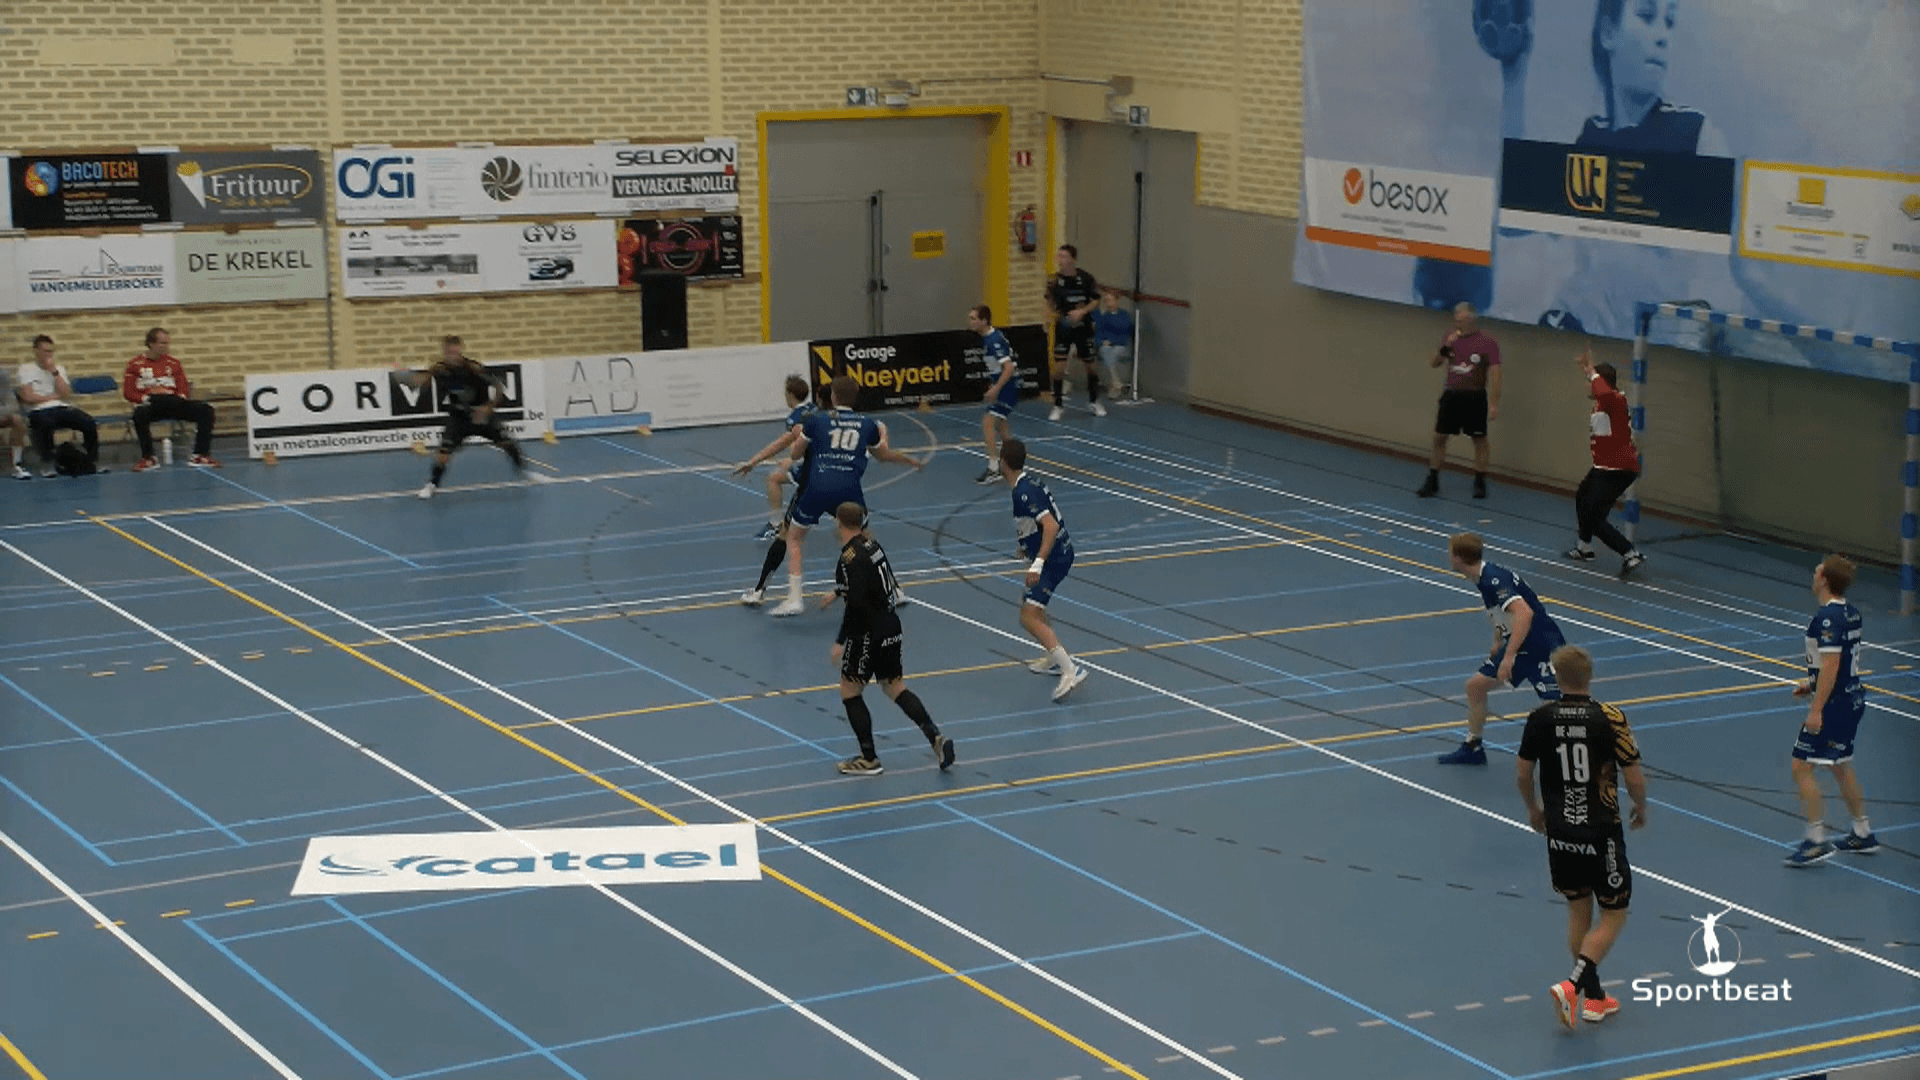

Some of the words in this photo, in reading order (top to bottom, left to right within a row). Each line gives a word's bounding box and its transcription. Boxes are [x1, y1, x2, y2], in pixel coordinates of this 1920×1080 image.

[62, 160, 138, 180] BACOTECH
[528, 162, 609, 189] finterio
[211, 174, 301, 196] Frituur
[614, 175, 735, 195] VERVAECKE-NOLLET
[1369, 168, 1448, 215] besox
[188, 253, 219, 272] DE
[225, 250, 312, 271] KREKEL
[845, 344, 897, 362] Garage
[846, 360, 951, 392] Naeyaert
[252, 371, 517, 416] CORVN
[253, 441, 279, 451] van
[283, 430, 408, 450] metaalconstructie
[828, 428, 860, 450] 10
[1556, 743, 1590, 782] 19
[1550, 838, 1597, 856] ATOYA
[415, 843, 737, 877] catael
